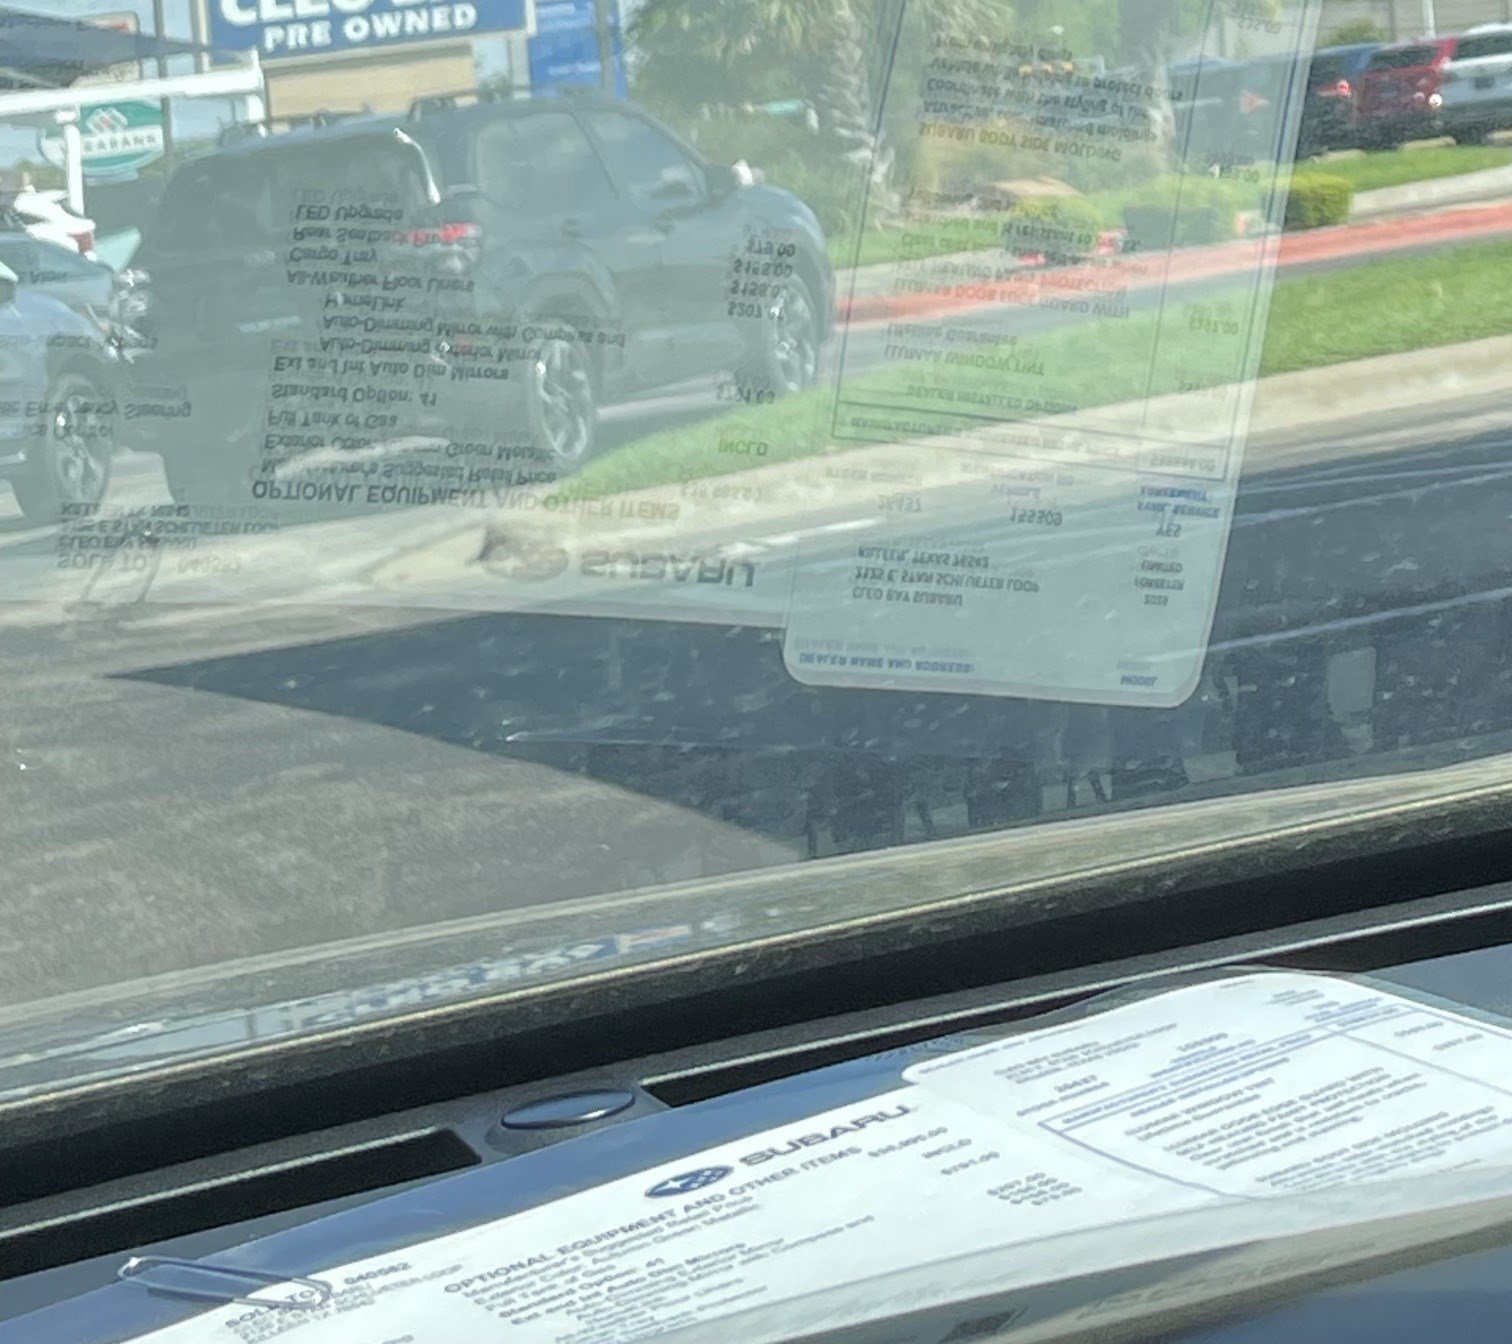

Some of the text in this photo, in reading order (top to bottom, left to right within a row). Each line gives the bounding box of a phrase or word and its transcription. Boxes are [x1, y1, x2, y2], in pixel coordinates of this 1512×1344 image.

[264, 2, 478, 51] PRE OWNED
[739, 1104, 913, 1166] SUBARU
[443, 1145, 863, 1294] OPTIONAL EQUIPMENT AND OTHER ITEMS
